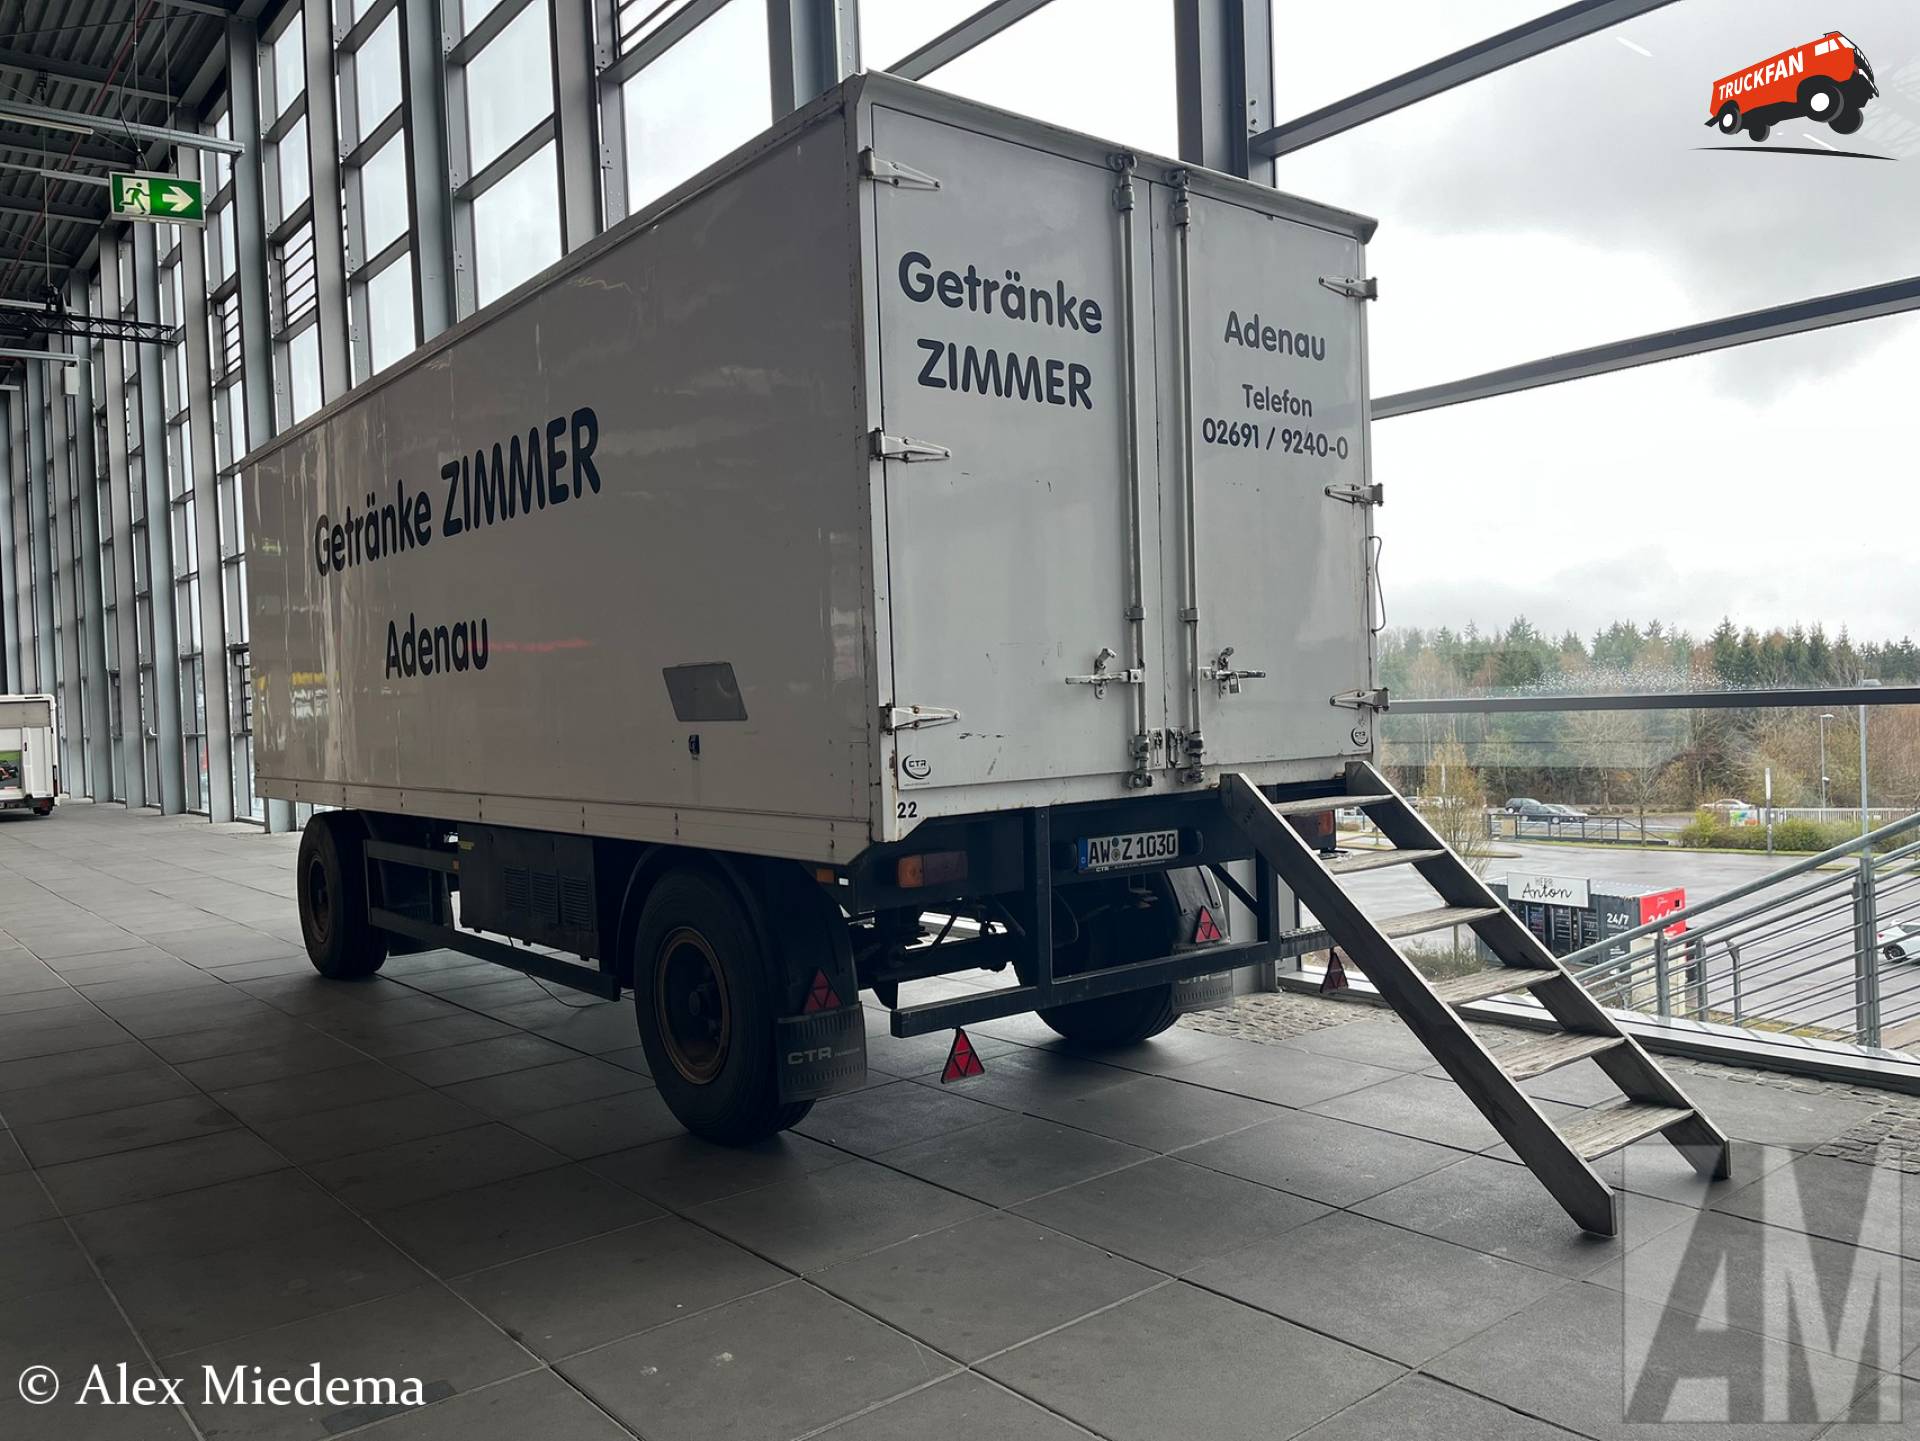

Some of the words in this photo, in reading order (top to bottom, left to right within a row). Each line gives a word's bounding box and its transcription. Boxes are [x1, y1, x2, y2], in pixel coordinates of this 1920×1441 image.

[898, 251, 1102, 334] Getränke
[1224, 310, 1326, 361] Adenau
[916, 338, 1093, 410] ZIMMER
[1241, 383, 1313, 418] Telefon
[1202, 417, 1259, 449] 02691
[1281, 428, 1349, 460] 9240-0
[314, 479, 432, 577] Getränke
[440, 407, 601, 538] ZIMMER
[385, 612, 489, 680] Adenau
[908, 759, 926, 768] CTR
[897, 801, 918, 819] 22
[1522, 882, 1573, 899] Anton
[1606, 912, 1630, 925] 24/7
[787, 1046, 832, 1065] CTR
